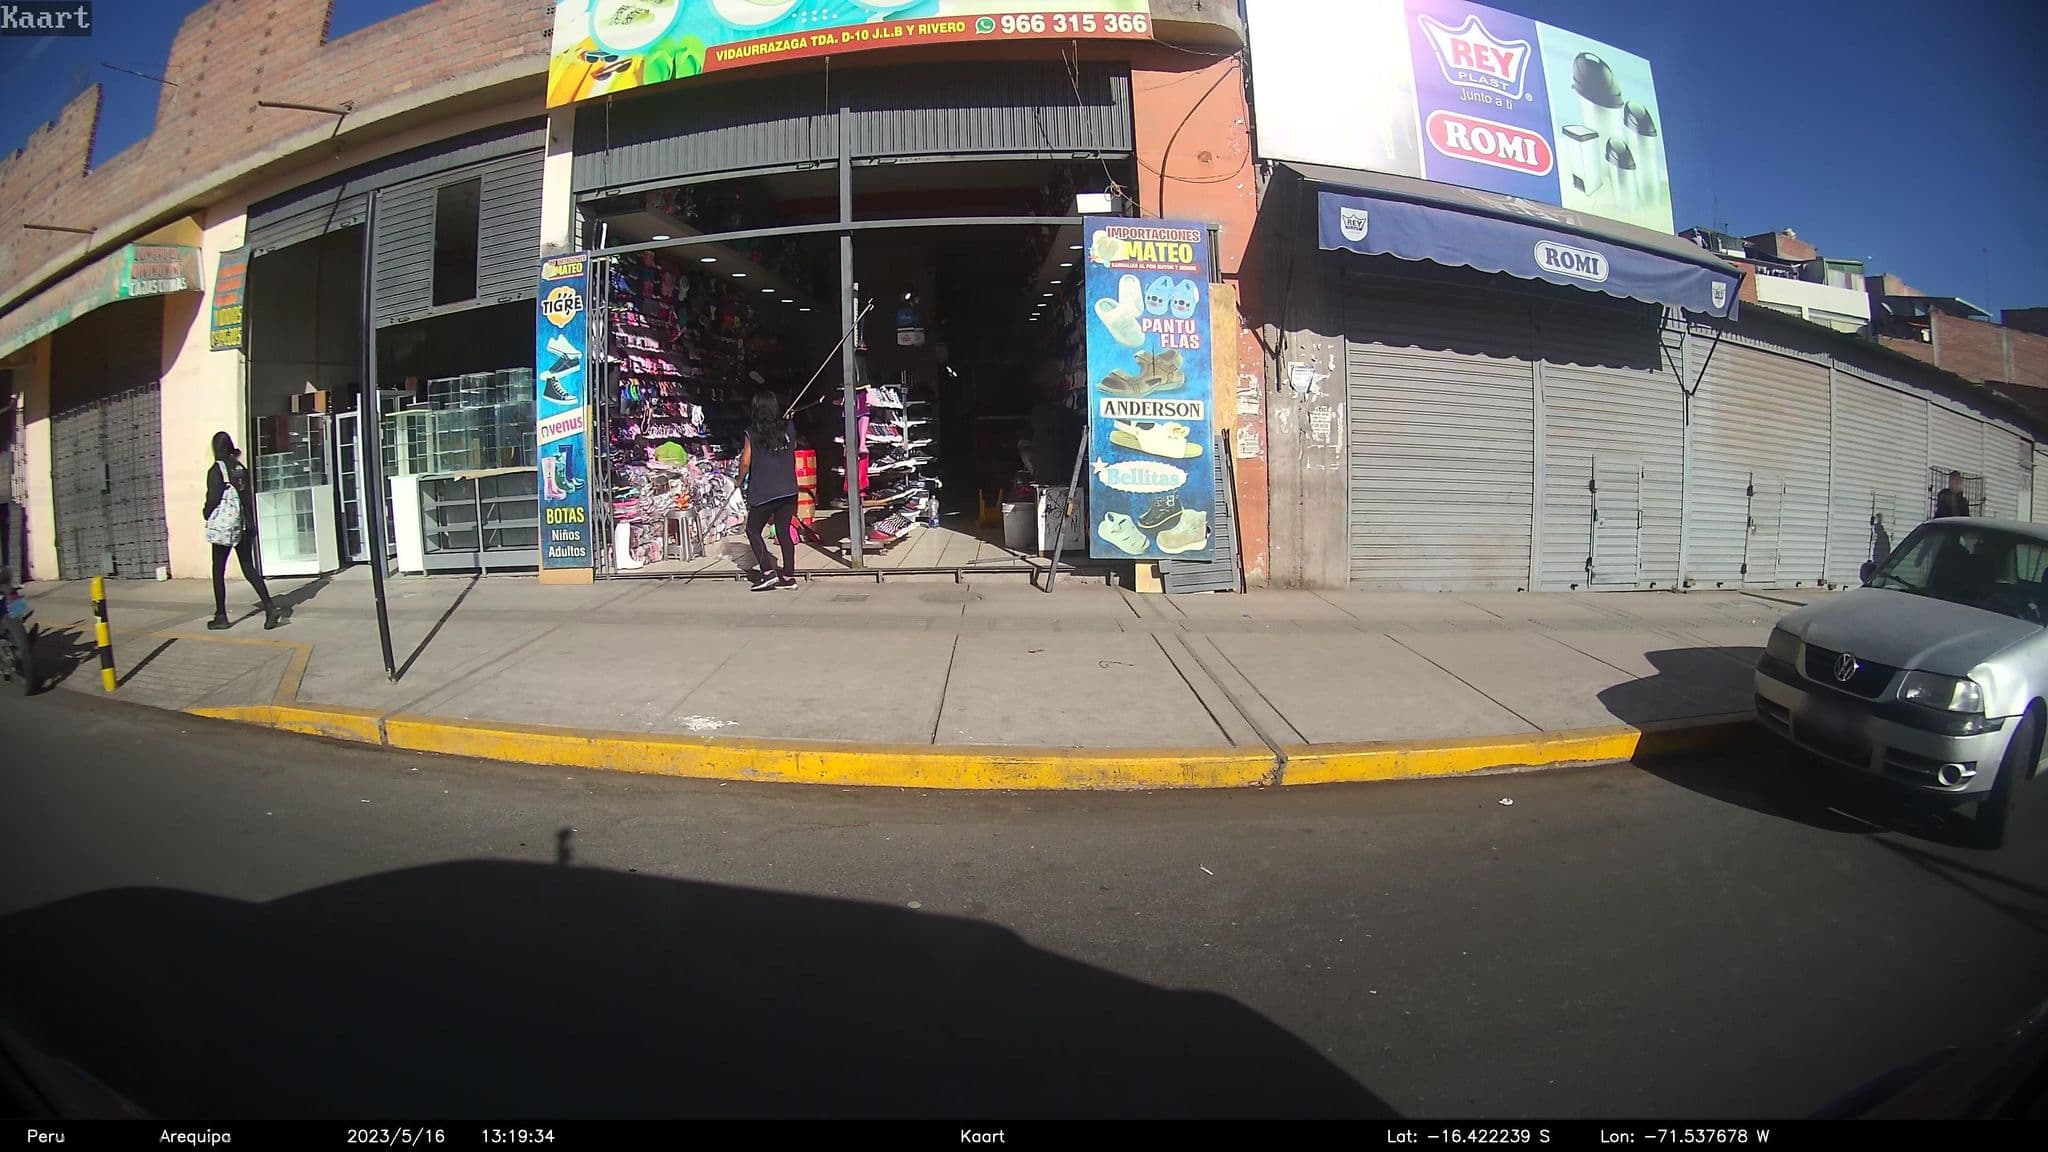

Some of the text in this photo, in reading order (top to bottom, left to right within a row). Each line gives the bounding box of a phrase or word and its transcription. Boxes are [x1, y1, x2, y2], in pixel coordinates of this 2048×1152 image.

[1000, 13, 1148, 34] 966 315 366
[716, 21, 966, 62] VIDAURRAZAGA TDA. D-10 J.L.B Y RIVERO
[1450, 37, 1514, 78] REY
[1457, 71, 1510, 91] PLAST
[1460, 88, 1513, 110] Junto a ti
[1443, 119, 1540, 166] ROMI
[1346, 218, 1363, 227] REY
[1107, 226, 1200, 242] IMPORTACIONES
[1122, 240, 1193, 264] MATEO
[1544, 247, 1600, 276] ROMI
[554, 262, 583, 276] MATEO
[542, 296, 582, 315] TIGRE
[1142, 317, 1196, 334] PANTU
[1160, 333, 1200, 349] FLAS
[1103, 400, 1201, 417] ANDERSON
[548, 416, 583, 435] venus
[1106, 467, 1180, 486] Bellitas
[546, 506, 585, 525] BOTAS
[551, 529, 581, 541] Niños
[548, 545, 586, 558] Adultos
